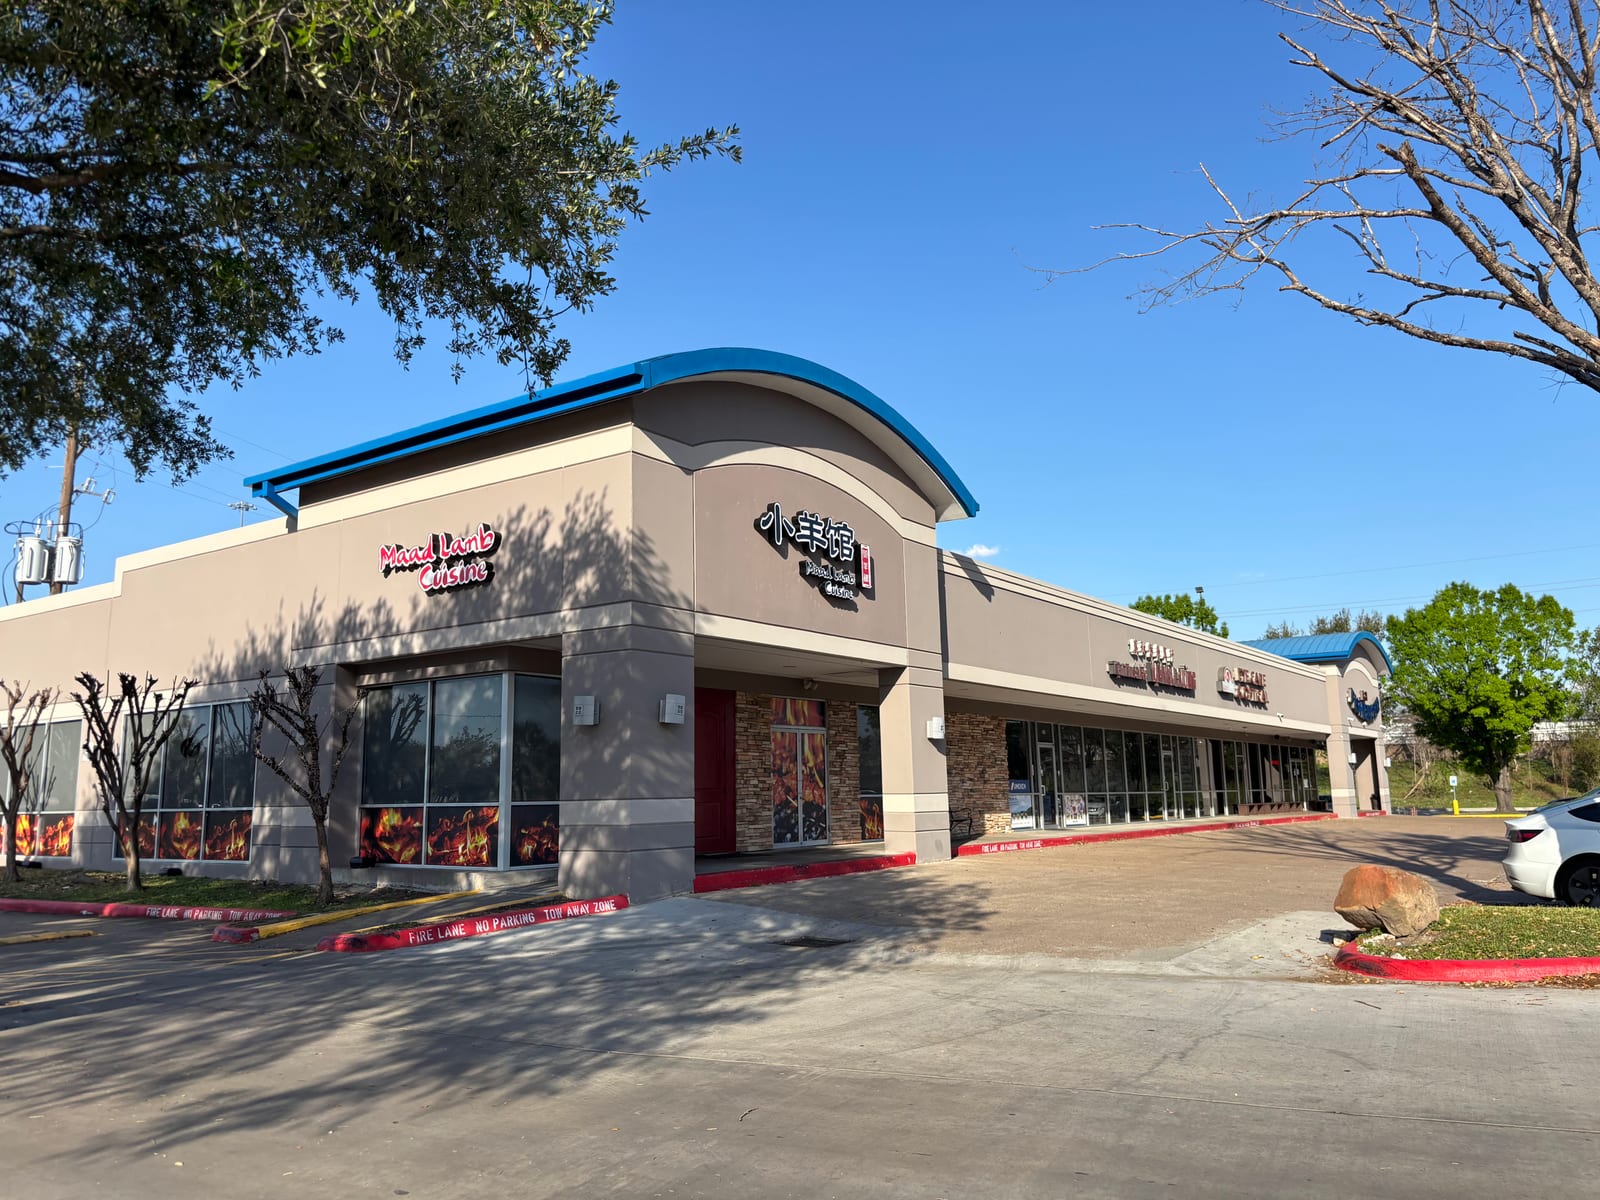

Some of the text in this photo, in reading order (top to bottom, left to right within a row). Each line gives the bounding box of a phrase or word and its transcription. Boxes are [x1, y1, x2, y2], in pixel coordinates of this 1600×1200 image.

[379, 523, 496, 574] Maad Lamb
[760, 502, 855, 561] 小羊馆
[418, 560, 489, 592] Cuisine
[825, 580, 855, 600] Cuisine
[145, 907, 161, 917] FIRE
[161, 907, 180, 918] LANE
[183, 909, 193, 919] NO
[193, 909, 223, 920] PARKING
[229, 910, 242, 920] TOW
[408, 899, 617, 944] FIRE LANE NO PARKING TOW AWAY ZONE
